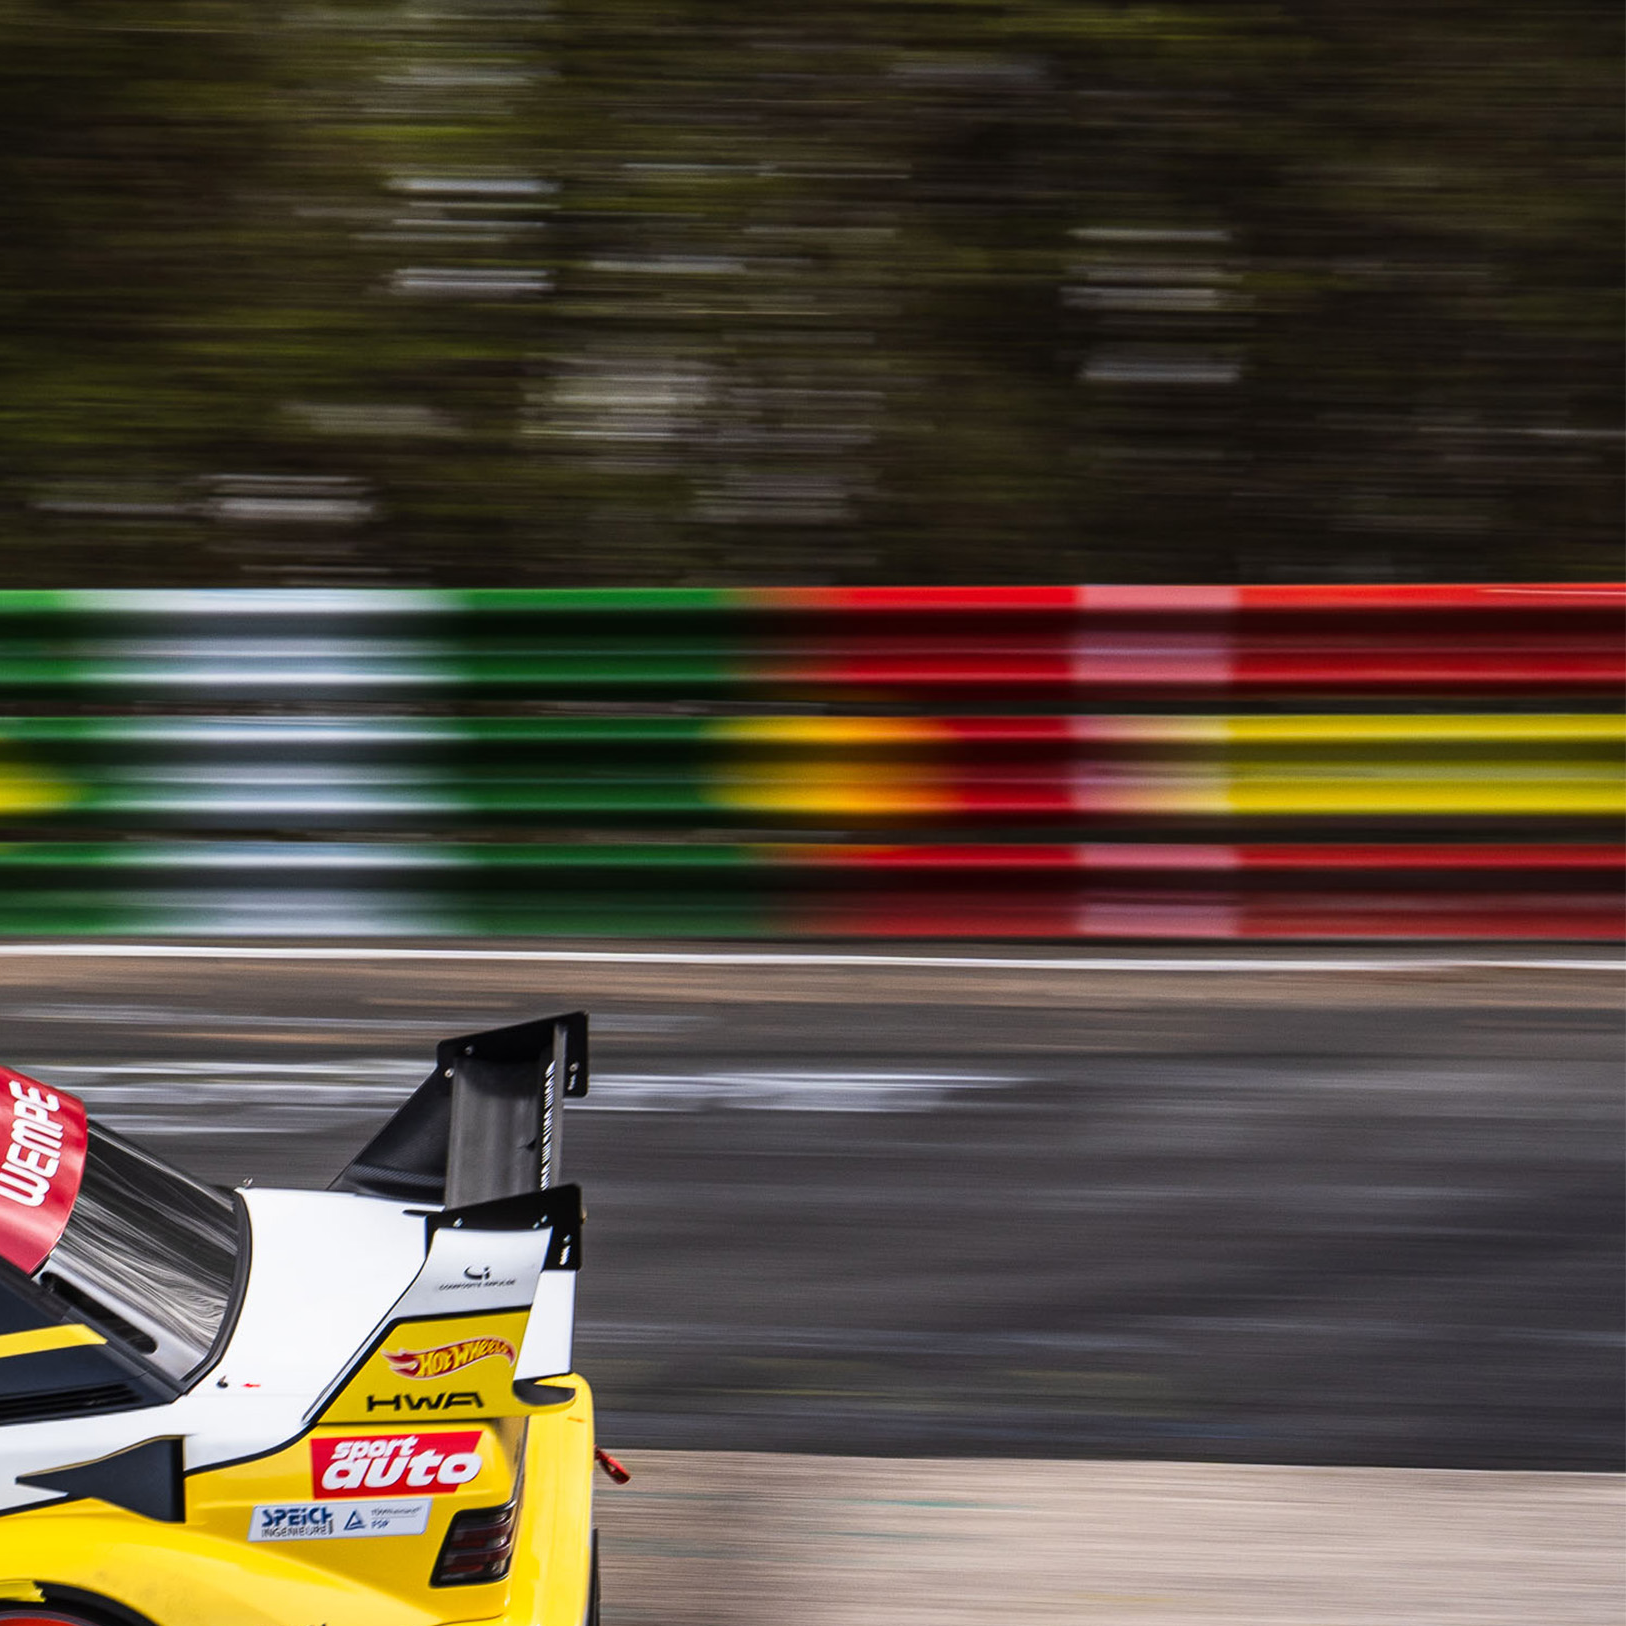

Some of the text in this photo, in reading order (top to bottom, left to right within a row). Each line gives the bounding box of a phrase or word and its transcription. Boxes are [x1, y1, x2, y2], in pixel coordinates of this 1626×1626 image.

[367, 1391, 485, 1412] HWA
[331, 1435, 420, 1463] sport
[321, 1449, 483, 1490] auto
